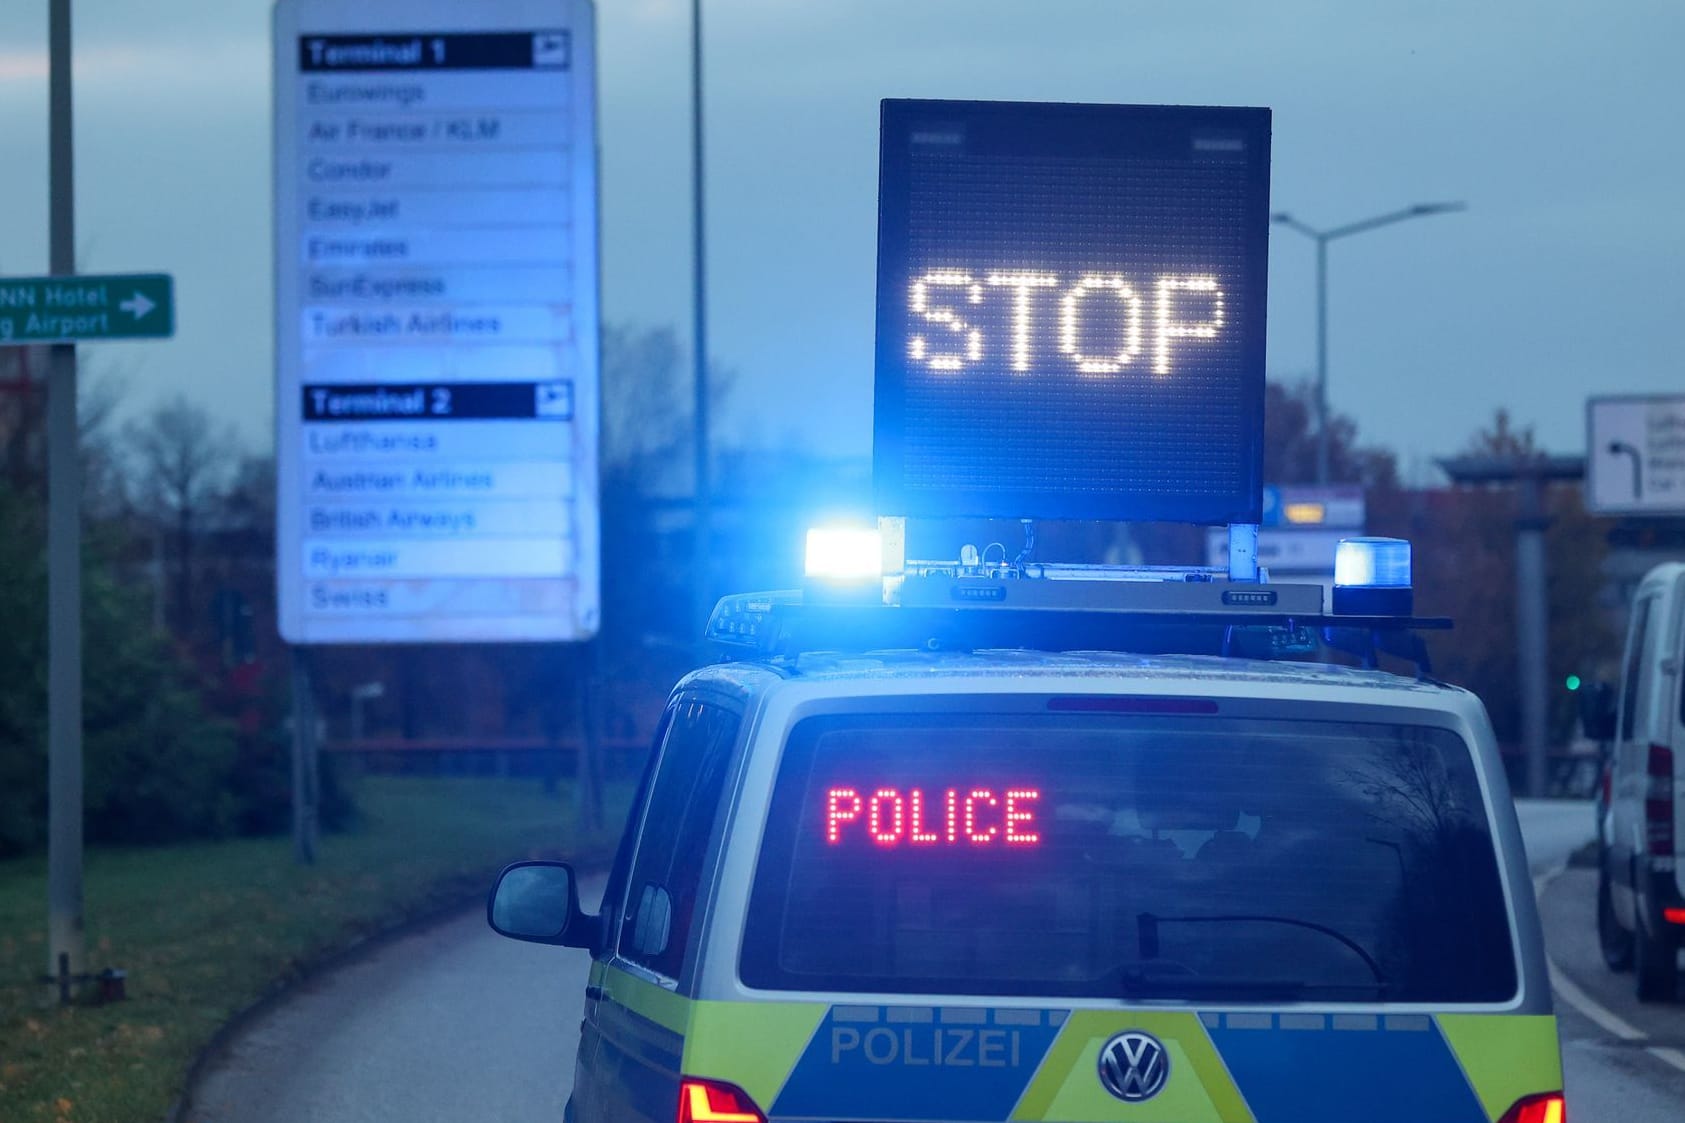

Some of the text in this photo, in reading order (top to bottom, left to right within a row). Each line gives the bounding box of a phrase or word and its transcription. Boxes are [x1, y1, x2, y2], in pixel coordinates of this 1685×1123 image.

[308, 38, 446, 65] Terminal 1
[307, 83, 425, 106] Eurowings
[309, 119, 340, 141] Air
[348, 118, 426, 141] France
[446, 117, 501, 140] KLM
[307, 158, 392, 181] Condor
[308, 237, 409, 259] Emirates
[45, 283, 108, 307] Hotel
[25, 312, 108, 338] Airport
[312, 312, 501, 335] Turkish Airlines
[907, 268, 1225, 375] STOP
[311, 387, 452, 416] Terminal 2
[309, 431, 438, 453] Lufthansa
[312, 468, 493, 490] Austrian Airlines
[310, 507, 476, 533] British Airways
[311, 583, 389, 608] Swiss
[828, 788, 1039, 843] POLICE
[831, 1026, 1020, 1068] POLIZEI
[1098, 1031, 1168, 1101] VW
